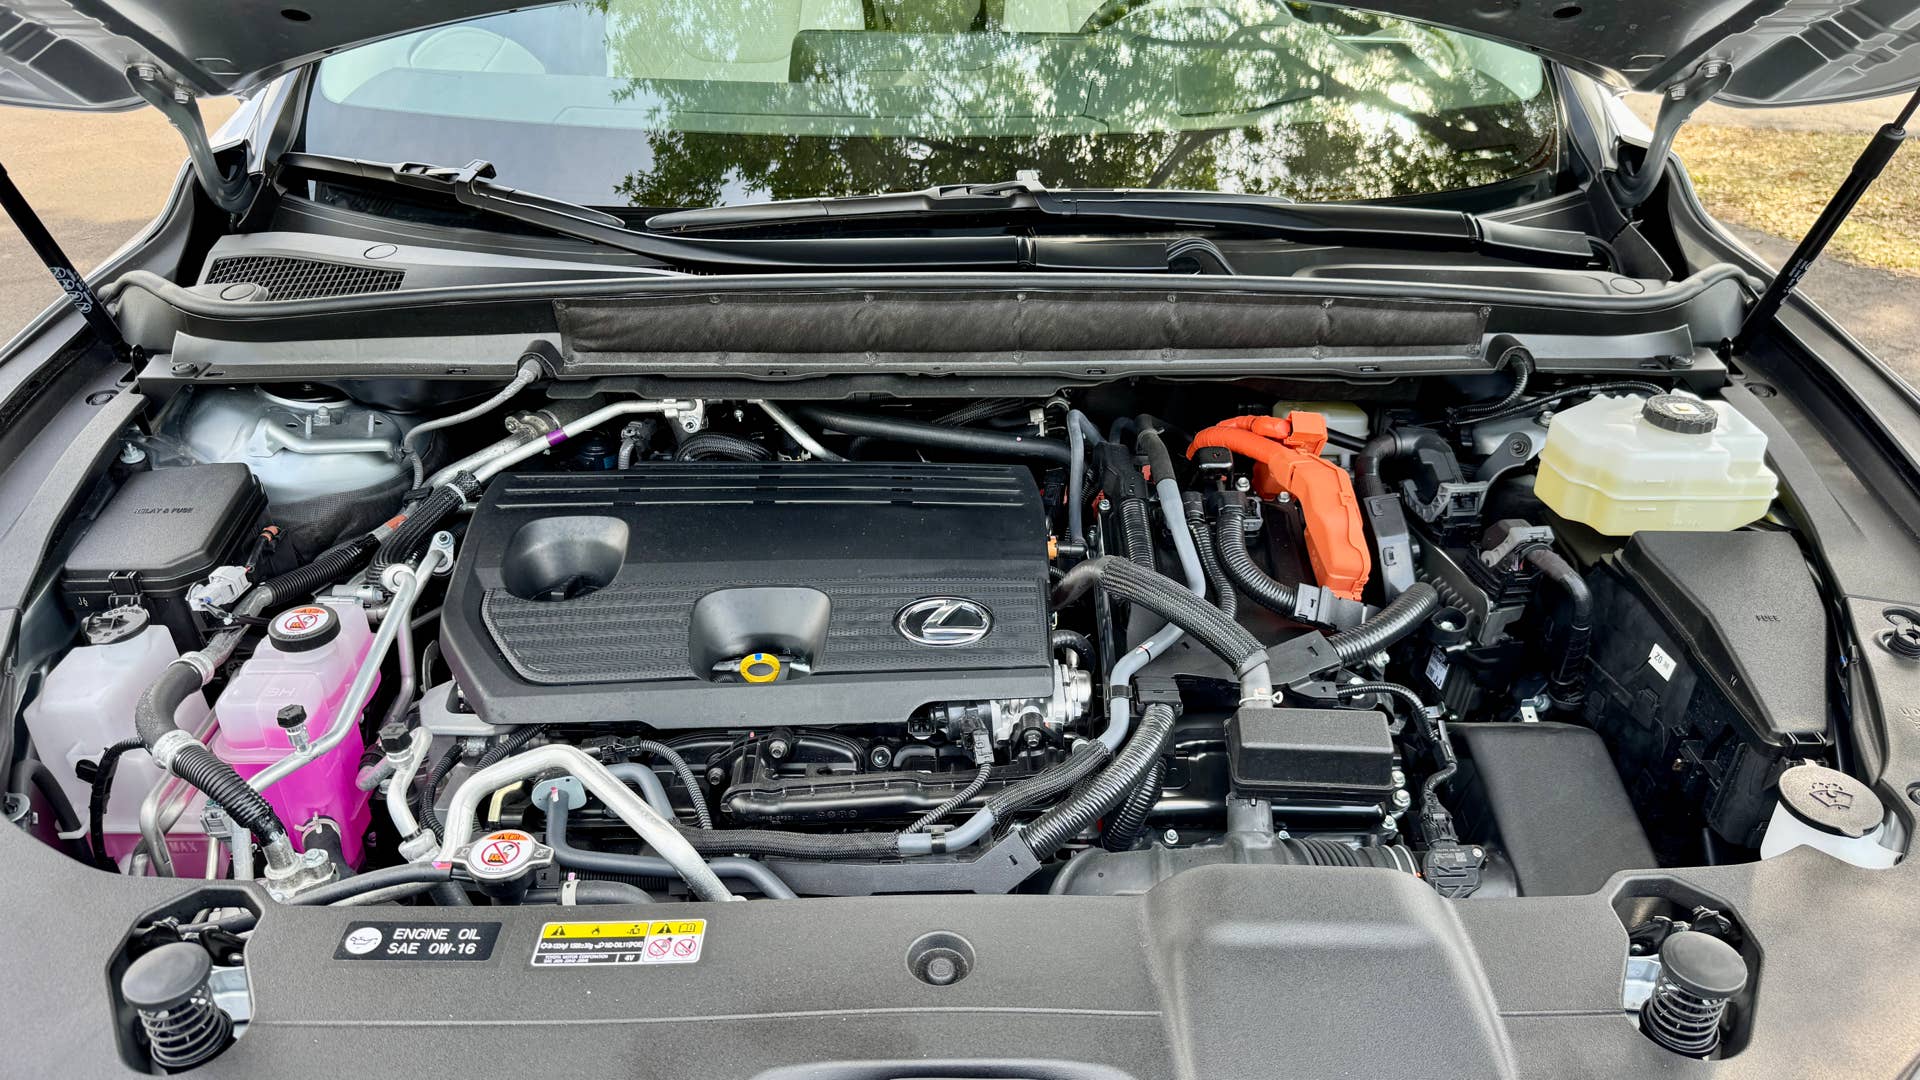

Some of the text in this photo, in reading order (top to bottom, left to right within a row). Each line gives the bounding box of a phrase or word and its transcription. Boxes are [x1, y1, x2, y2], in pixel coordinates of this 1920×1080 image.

[168, 841, 199, 853] MAX
[393, 928, 481, 940] ENGINE OIL
[387, 943, 477, 955] SAE 0W-16
